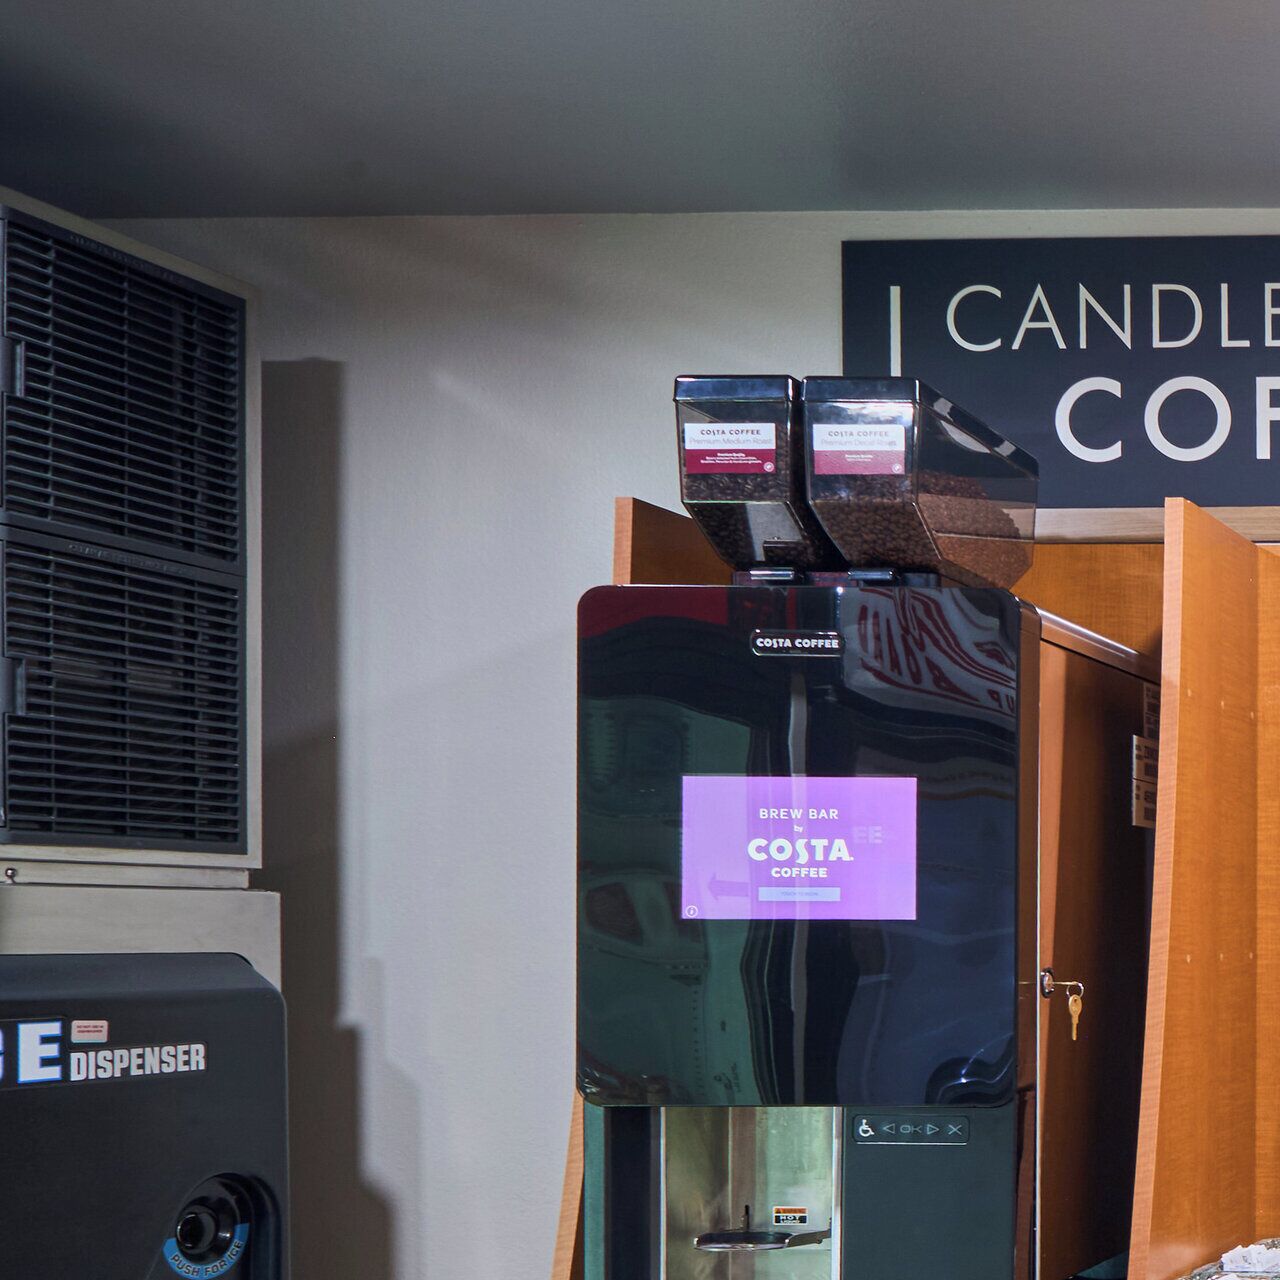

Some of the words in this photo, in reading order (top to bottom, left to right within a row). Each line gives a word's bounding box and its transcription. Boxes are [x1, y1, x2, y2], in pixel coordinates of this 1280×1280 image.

[756, 638, 792, 648] COSTA
[795, 638, 839, 648] COFFEE
[760, 808, 803, 819] BREW
[808, 808, 839, 819] BAR
[747, 838, 853, 864] COSTA
[771, 867, 828, 878] COFFEE
[70, 1043, 206, 1081] DISPENSER
[899, 1124, 923, 1135] OK
[170, 1252, 200, 1278] PUSH
[203, 1259, 228, 1277] FOR
[226, 1239, 244, 1262] ICE
